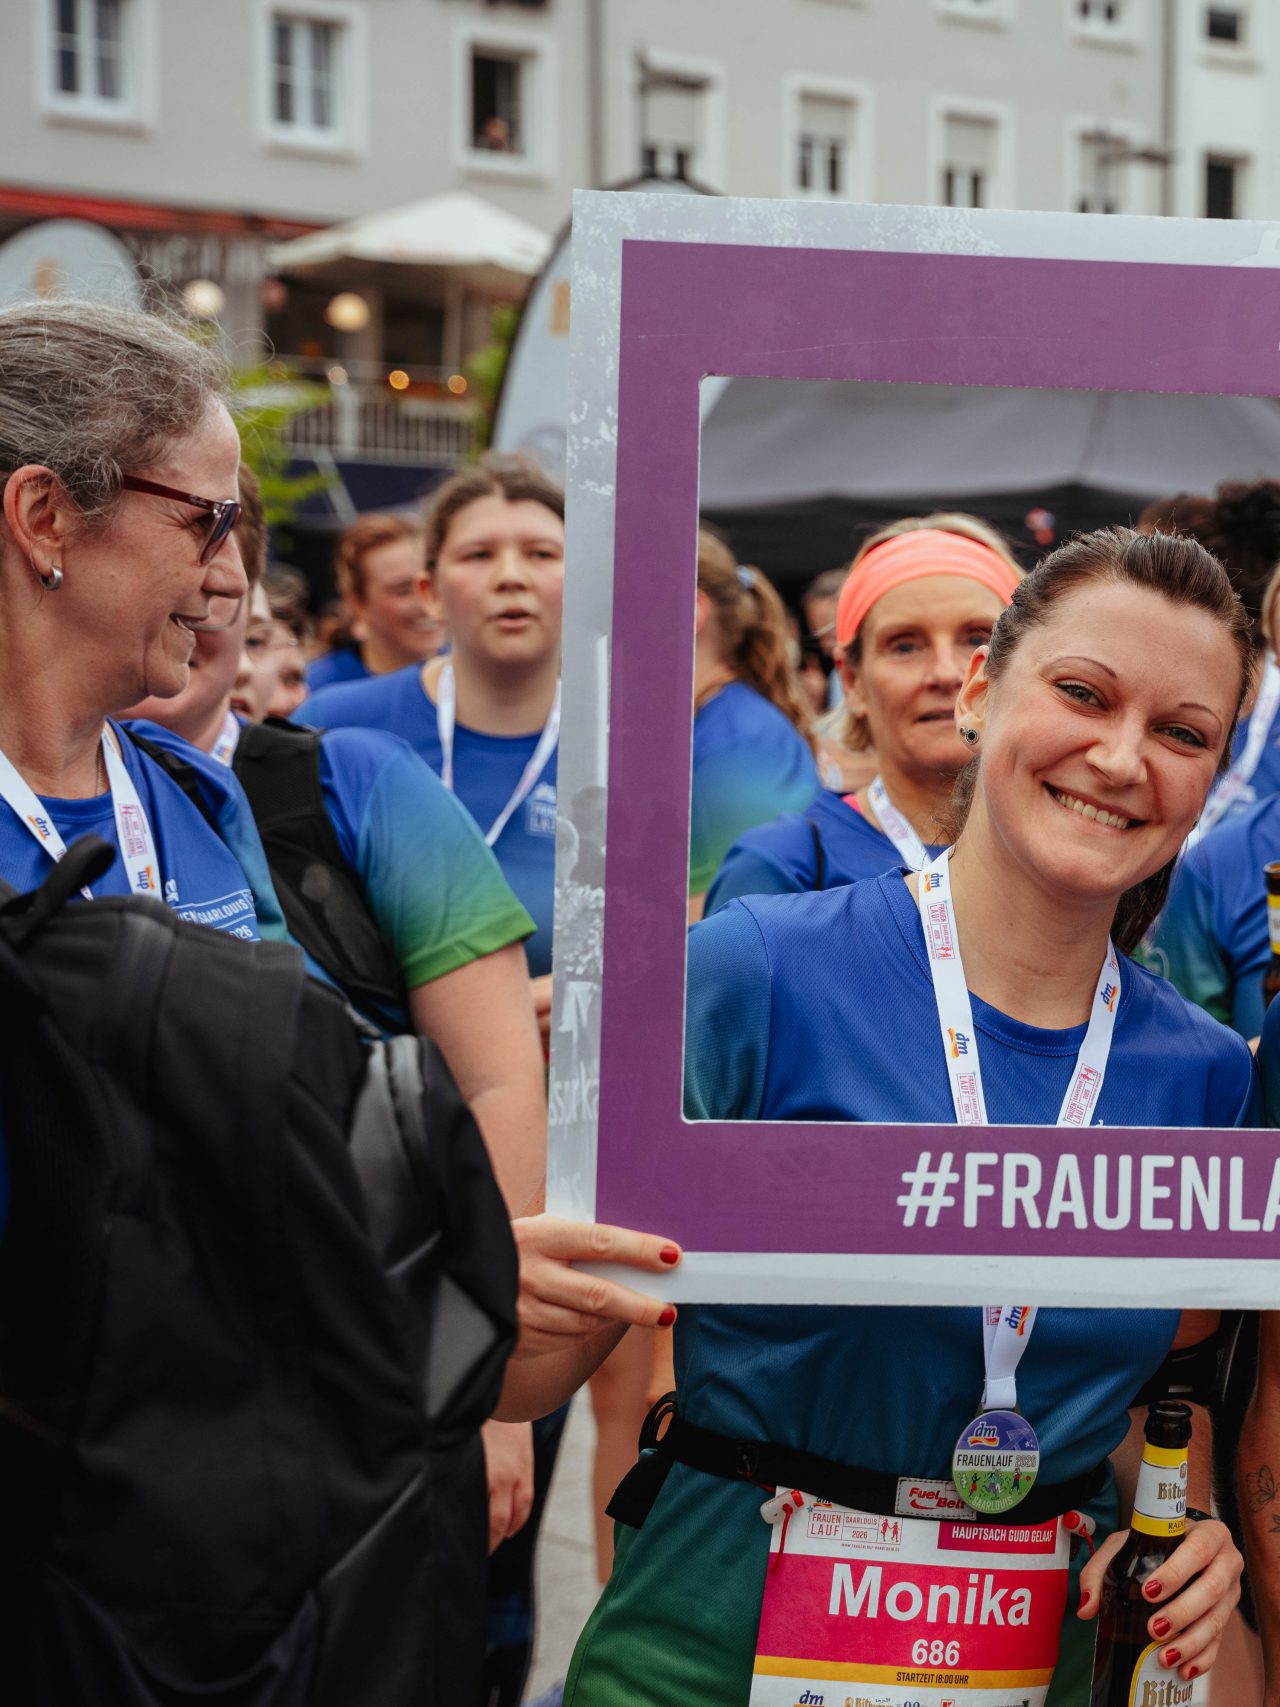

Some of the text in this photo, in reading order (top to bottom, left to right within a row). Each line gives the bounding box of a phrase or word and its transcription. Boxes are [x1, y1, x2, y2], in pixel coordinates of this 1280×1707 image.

[35, 817, 50, 838] dm
[137, 870, 149, 890] dm
[931, 873, 943, 888] dm
[930, 904, 940, 923] LAUF
[1101, 983, 1113, 1005] dm
[956, 1032, 970, 1055] dm
[960, 1075, 970, 1095] LAUF
[1066, 1102, 1078, 1121] FRAUEN
[1073, 1103, 1086, 1125] LAUF
[1005, 1306, 1023, 1330] dm
[975, 1421, 997, 1438] dm
[957, 1453, 1037, 1468] FRAUENLAUF 2026
[909, 1487, 940, 1500] Fuel
[970, 1495, 1013, 1512] SAARLOUIS
[812, 1513, 842, 1524] FRAUEN
[845, 1516, 878, 1526] SAARLOUIS
[810, 1524, 840, 1536] LAUF
[852, 1530, 868, 1539] 2026
[952, 1526, 1053, 1543] HAUPTSACH GUDD GELAAF
[828, 1563, 1032, 1627] Monika
[911, 1638, 960, 1667] 686
[896, 1671, 969, 1685] STARTZEIT 18:00 UHR
[800, 1690, 824, 1706] dm
